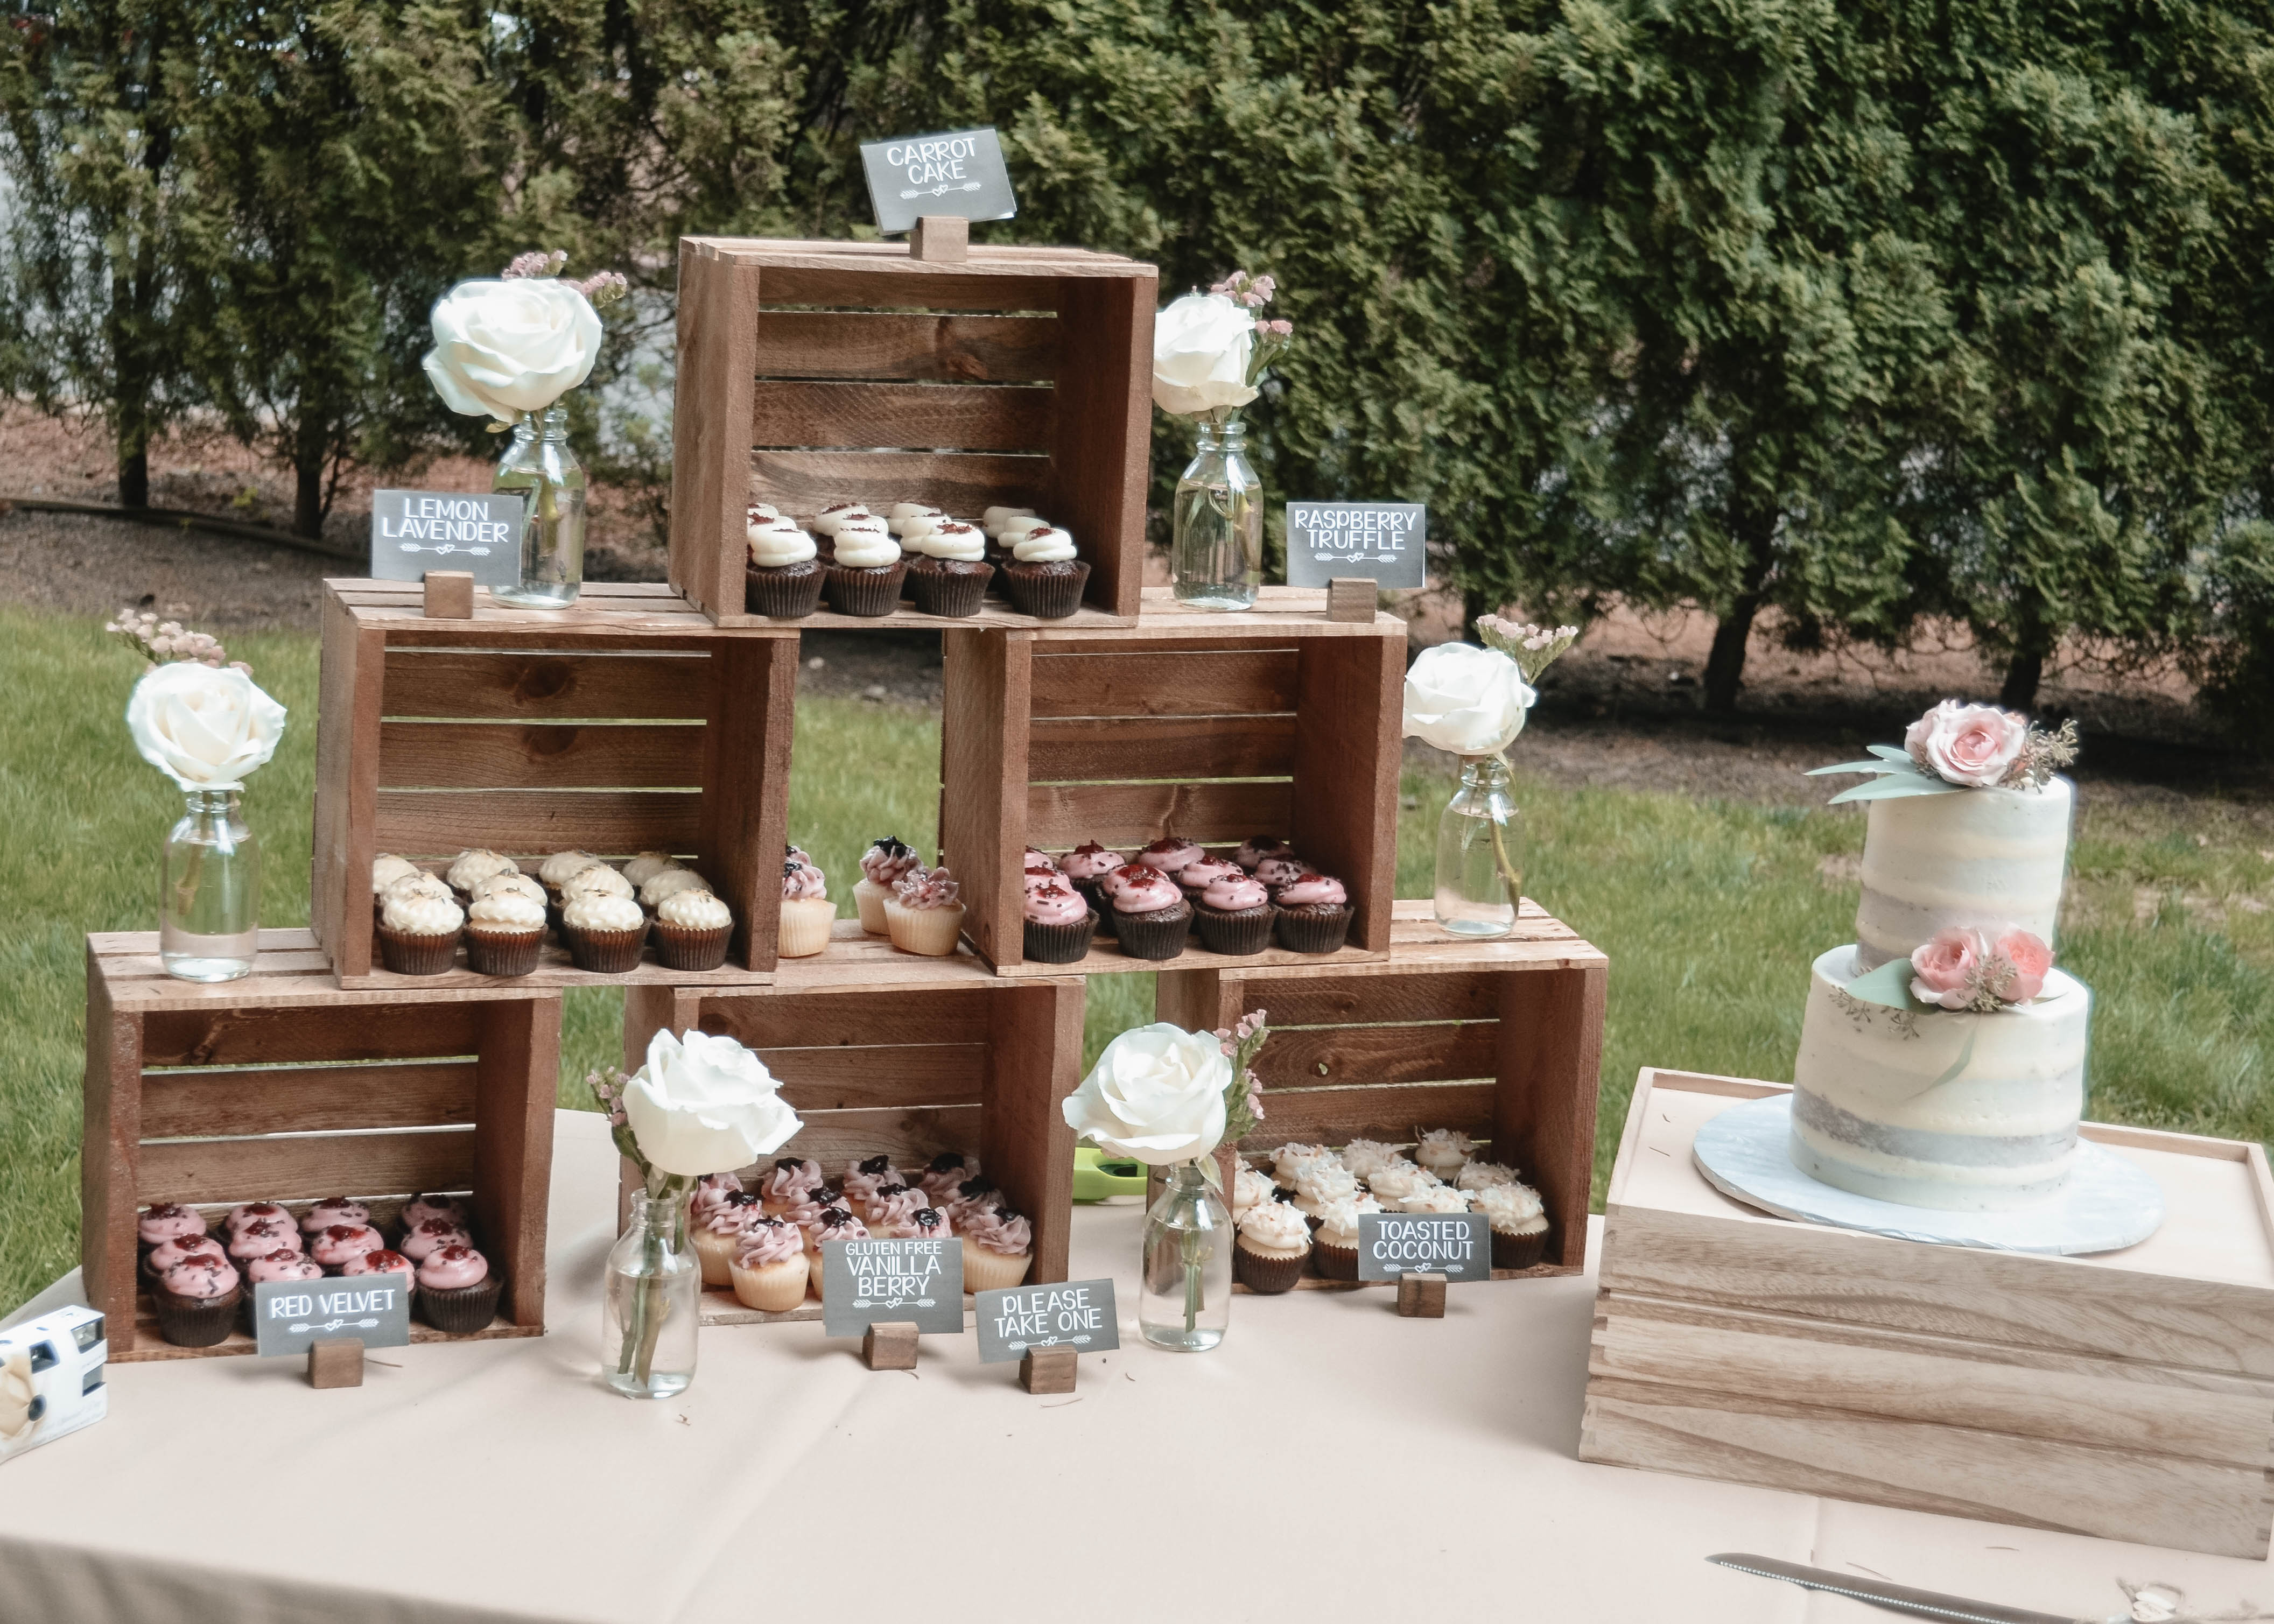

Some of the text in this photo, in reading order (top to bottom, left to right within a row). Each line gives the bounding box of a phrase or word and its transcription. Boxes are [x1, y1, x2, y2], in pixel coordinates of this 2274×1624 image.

[886, 137, 975, 166] CARROT
[908, 159, 967, 185] CAKE
[405, 497, 488, 522] LEMON
[1294, 509, 1417, 531] RASPBERRY
[382, 517, 510, 543] LAVENDER
[1306, 529, 1406, 550] TRUFFLE
[1377, 1220, 1470, 1240] TOASTED
[845, 1241, 943, 1256] GLUTEN FREE
[1372, 1240, 1473, 1260] COCONUT
[846, 1255, 942, 1276] VANILLA
[858, 1275, 930, 1297] BERRY
[271, 1289, 396, 1319] RED VELVET
[1002, 1288, 1091, 1317] PLEASE
[994, 1307, 1103, 1338] TAKE ONE
